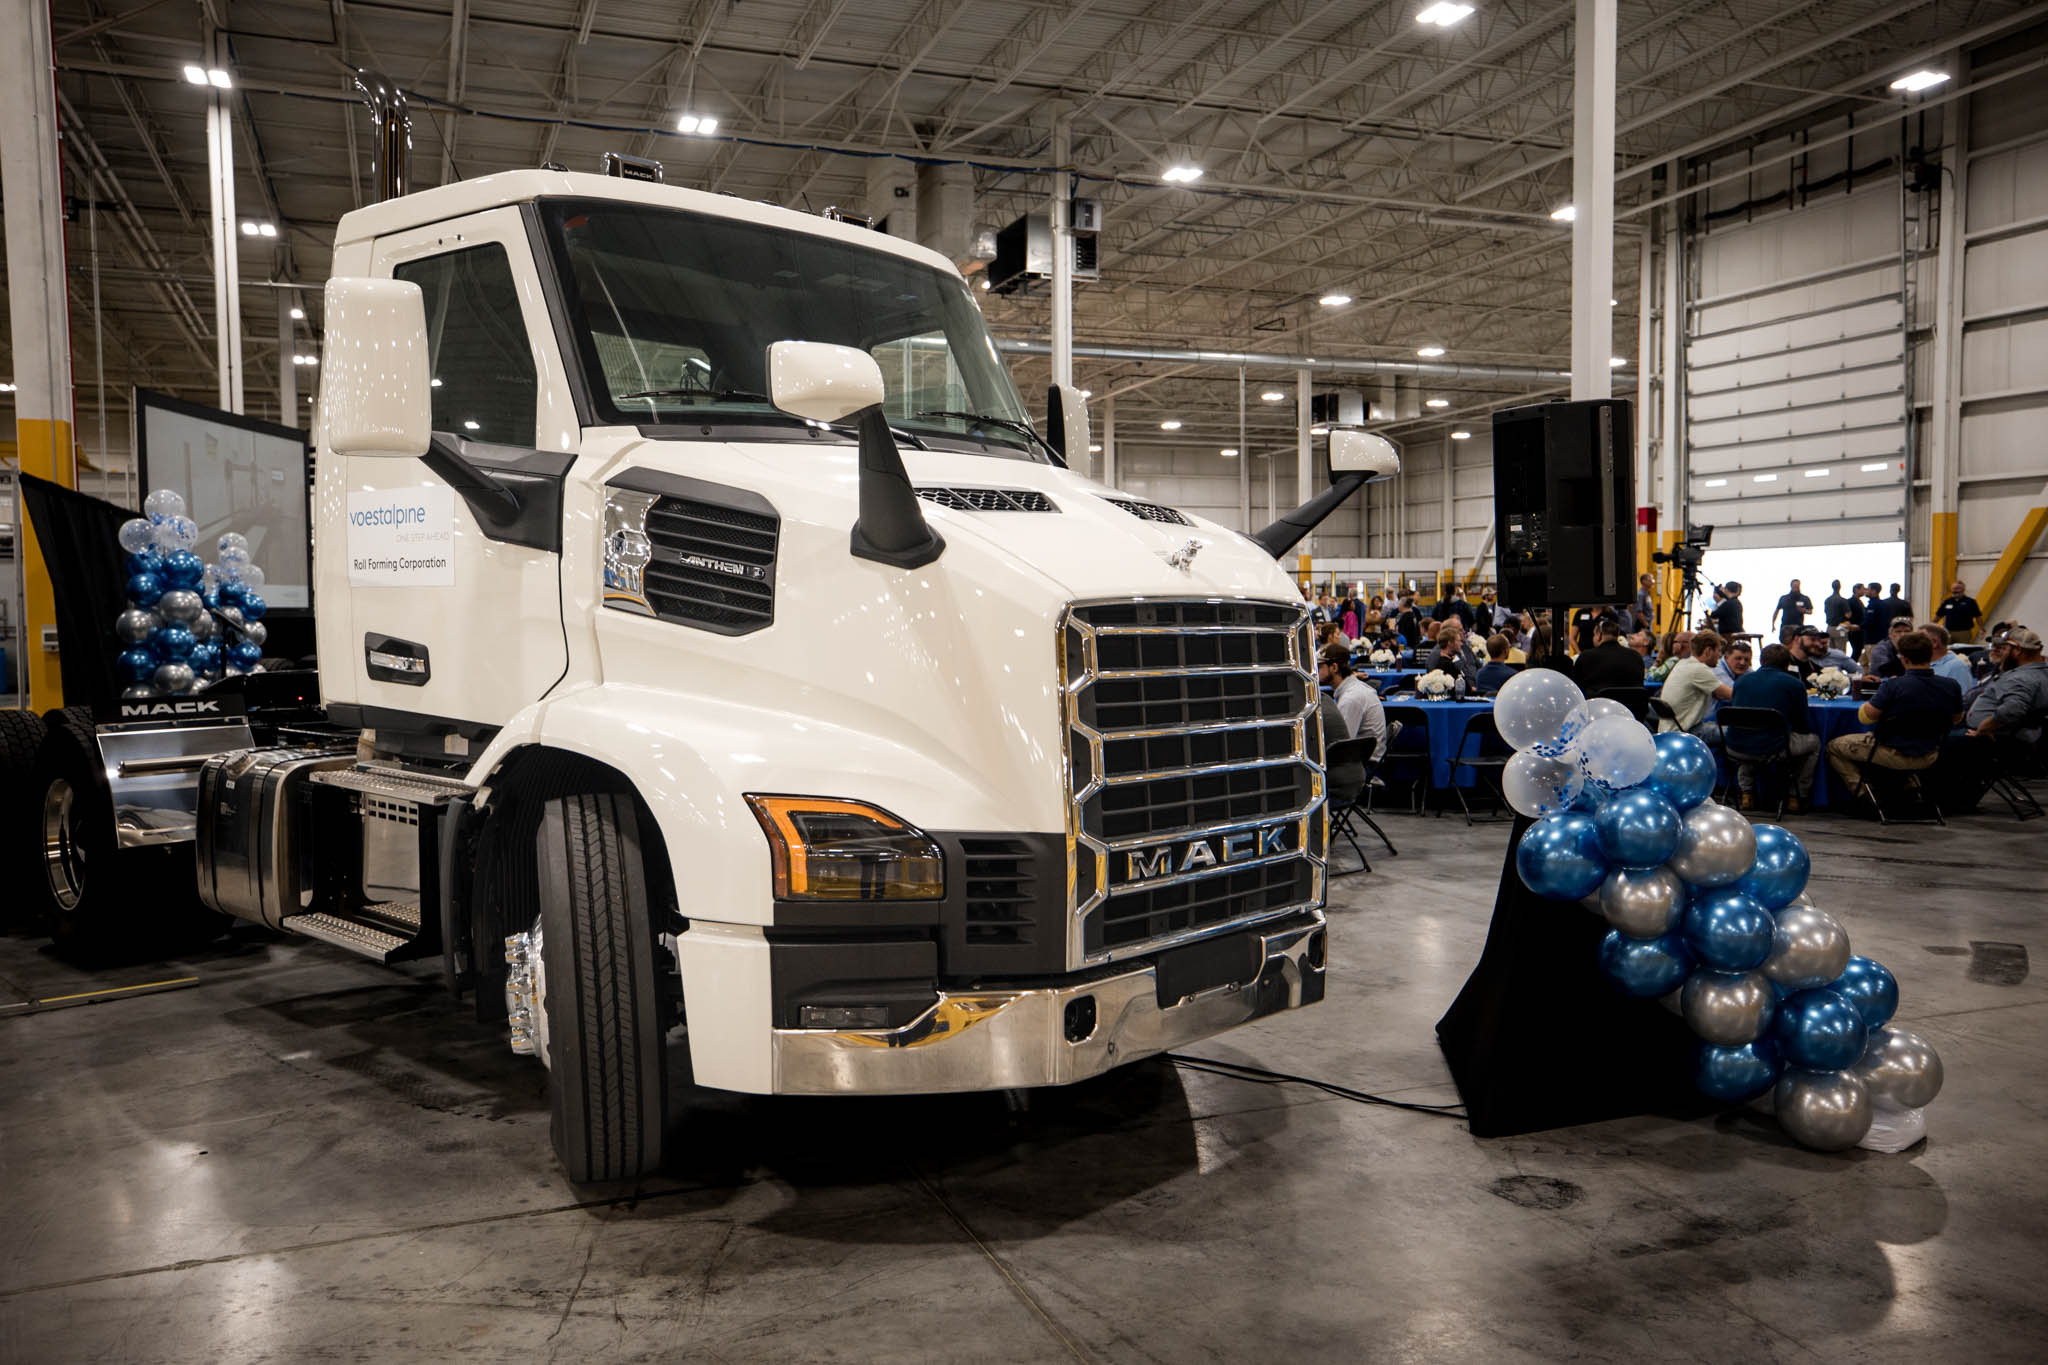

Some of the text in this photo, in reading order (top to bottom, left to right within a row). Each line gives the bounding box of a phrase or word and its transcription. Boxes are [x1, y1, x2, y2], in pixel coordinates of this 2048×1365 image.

[624, 169, 653, 179] MACK
[349, 504, 425, 529] voestalpine
[354, 556, 446, 572] Roll Forming Corporation
[680, 551, 744, 575] ANTHEM
[121, 700, 220, 717] MACK
[1127, 824, 1287, 881] MACK
